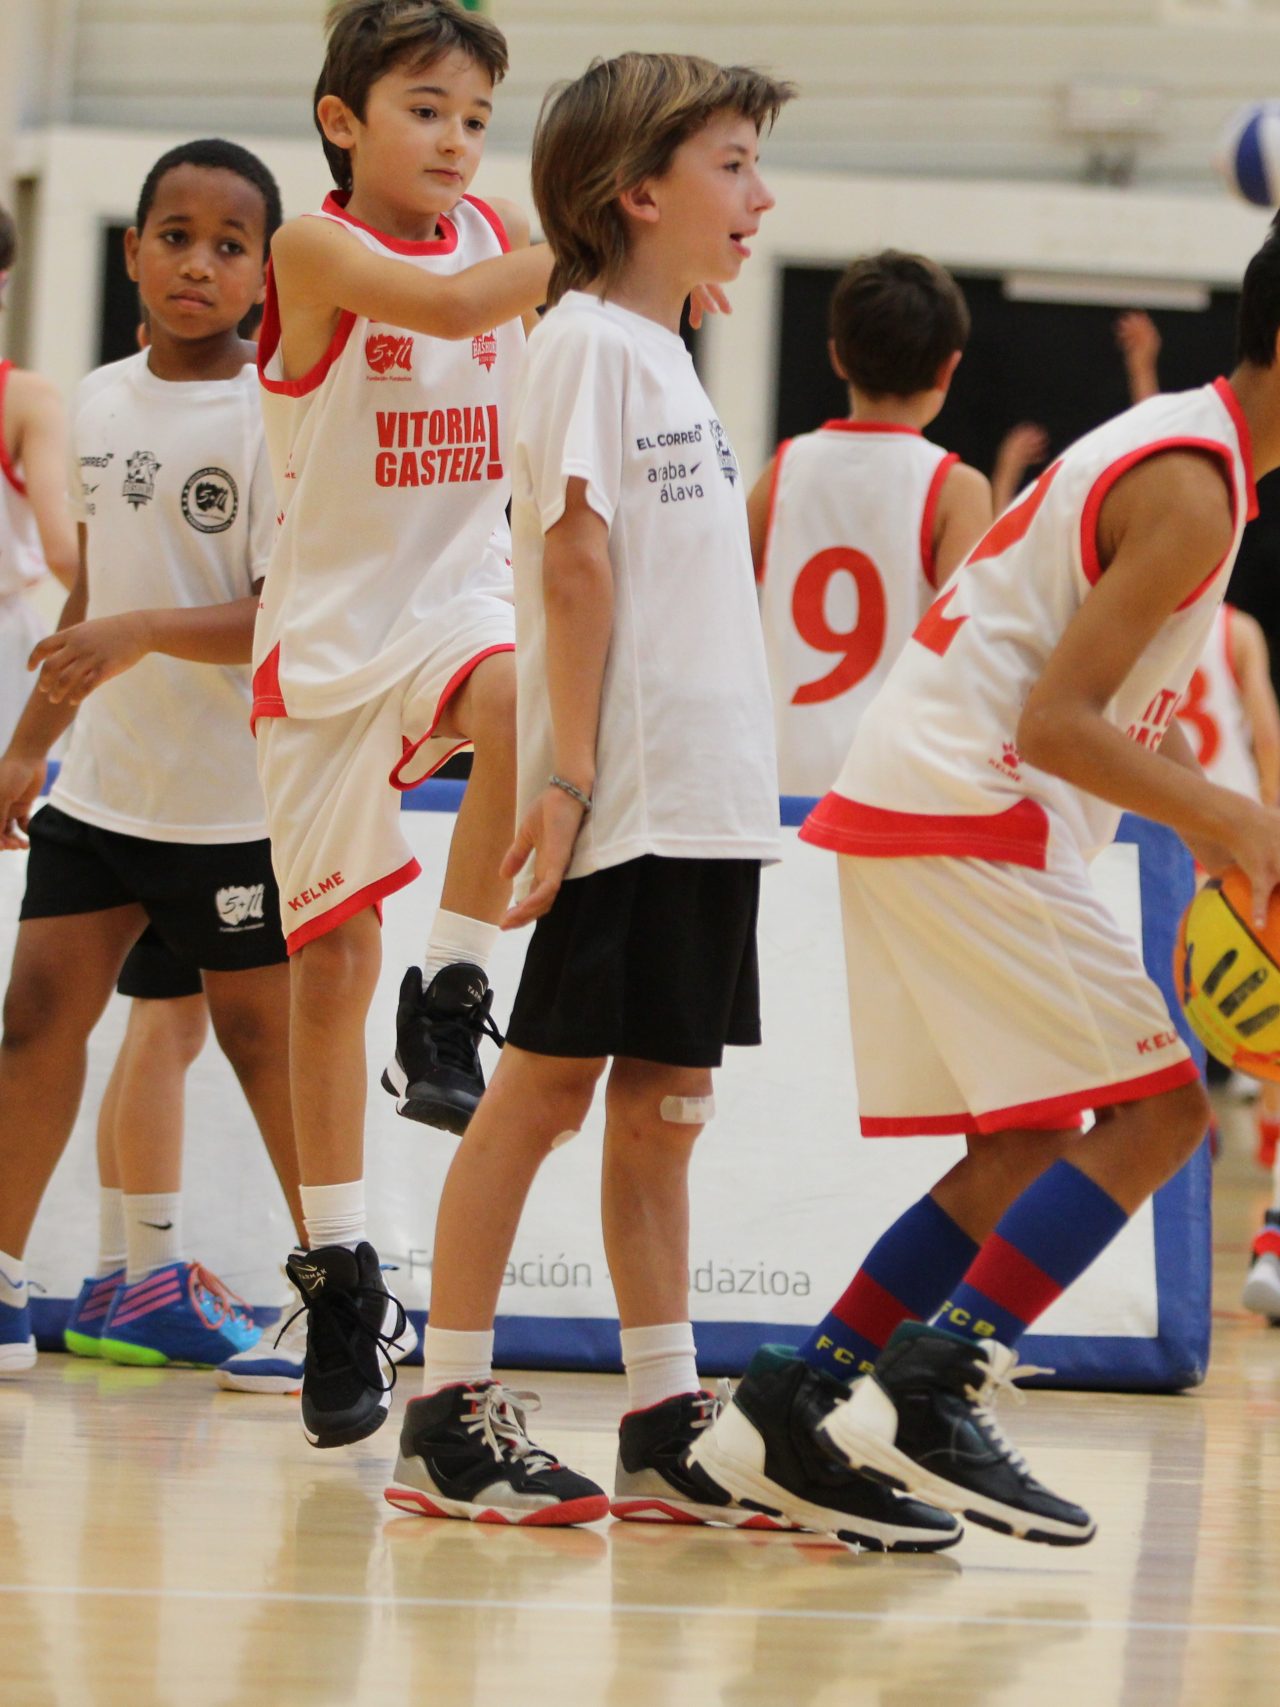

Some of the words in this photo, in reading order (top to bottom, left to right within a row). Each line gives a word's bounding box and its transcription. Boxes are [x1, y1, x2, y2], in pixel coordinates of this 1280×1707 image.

[376, 406, 486, 448] VITORIA
[637, 437, 656, 451] EL
[657, 430, 702, 447] CORREO
[648, 460, 687, 483] araba
[660, 482, 704, 503] álava
[791, 546, 887, 705] 9
[287, 871, 345, 911] KELME
[688, 1259, 811, 1296] dazioa
